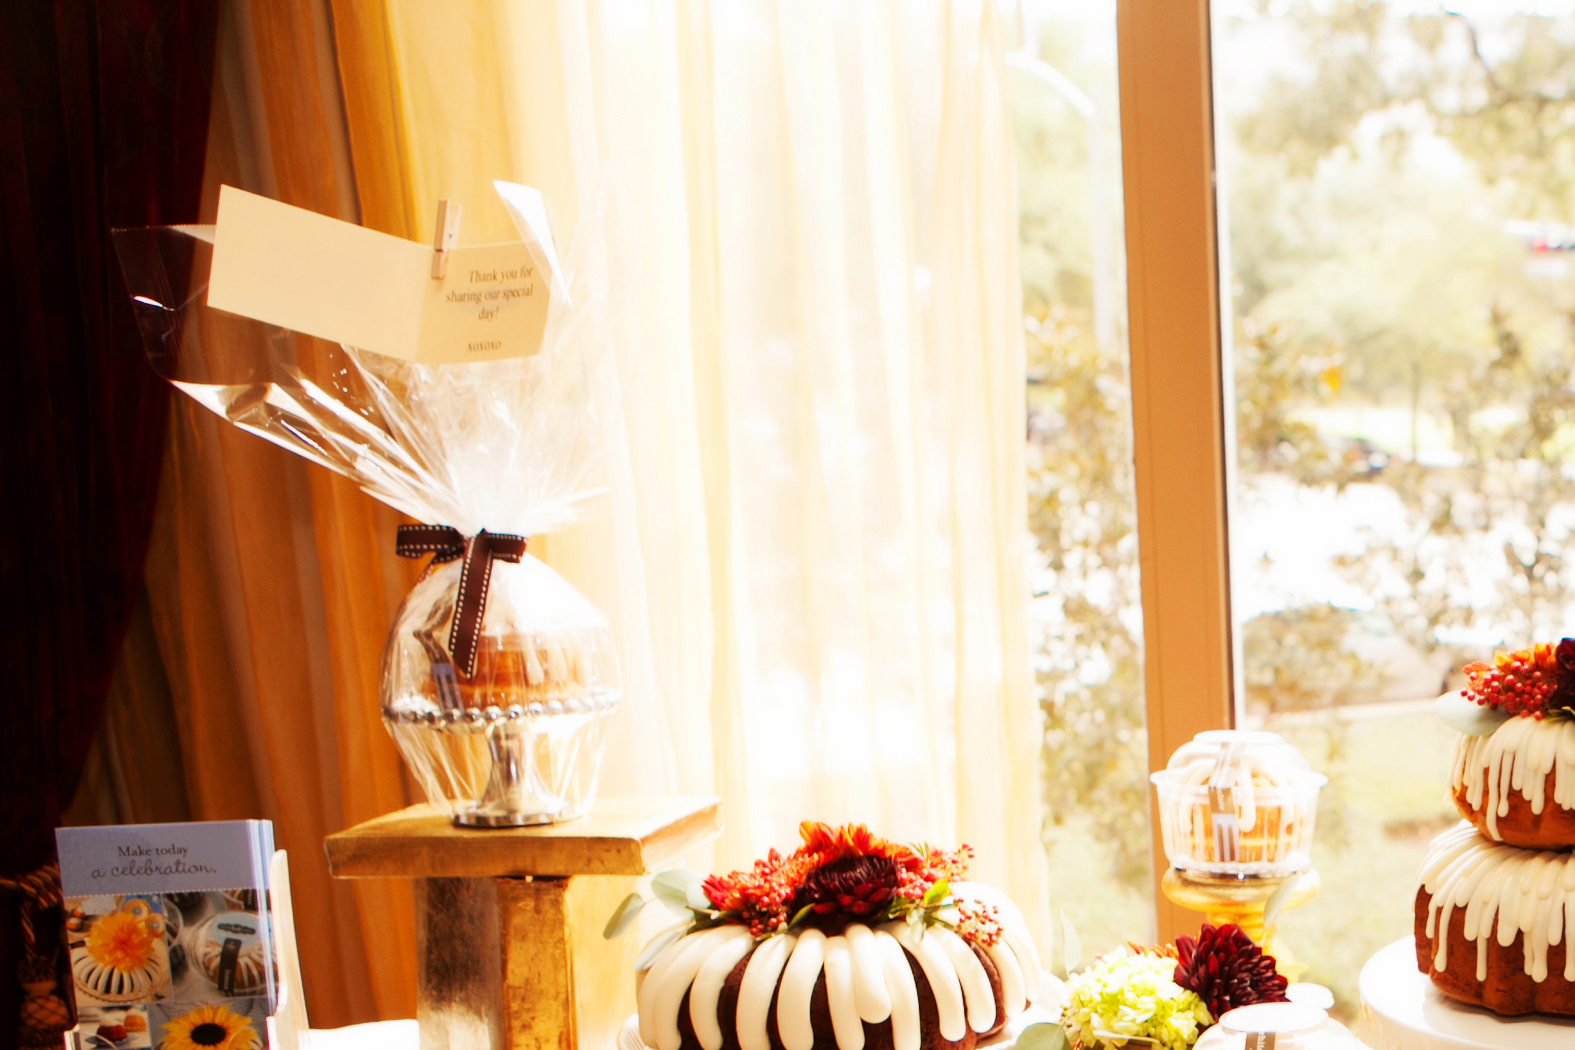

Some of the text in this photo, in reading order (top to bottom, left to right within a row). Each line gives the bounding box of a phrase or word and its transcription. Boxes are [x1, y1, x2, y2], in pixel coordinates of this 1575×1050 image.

[470, 264, 534, 284] Thank you for
[446, 283, 534, 305] sharing our special
[478, 306, 499, 323] day!
[117, 844, 189, 858] Make today
[91, 859, 217, 879] a celebration.
